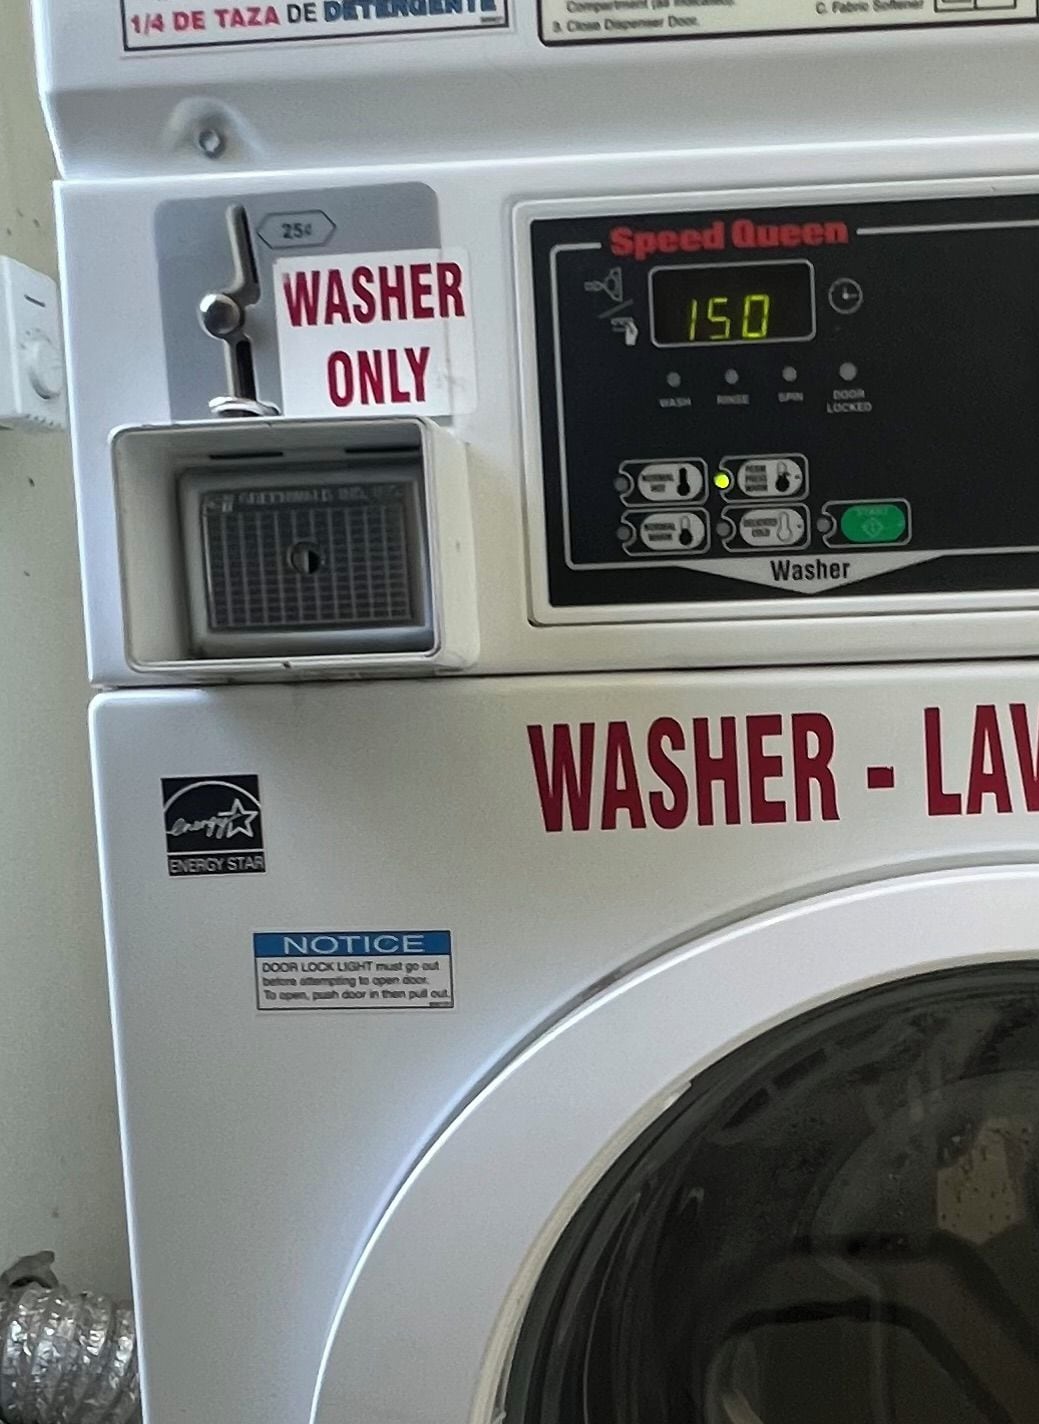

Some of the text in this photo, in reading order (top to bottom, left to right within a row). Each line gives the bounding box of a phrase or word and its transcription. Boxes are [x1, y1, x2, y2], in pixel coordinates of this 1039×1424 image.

[130, 13, 165, 36] 1/4
[172, 10, 206, 32] DE
[214, 6, 281, 29] TAZA
[287, 3, 318, 24] DE
[609, 219, 849, 262] Speed Queen
[282, 262, 466, 327] WASHER
[688, 293, 770, 342] 150
[327, 347, 431, 407] ONLY
[826, 401, 873, 413] LOCKED
[769, 558, 852, 582] Washer
[526, 711, 841, 833] WASHER
[866, 765, 895, 790] -
[169, 855, 265, 874] ENERGY STAR
[283, 934, 426, 955] NOTICE
[262, 961, 299, 973] DOOR
[300, 961, 335, 973] LOCK
[336, 960, 374, 972] LIGHT
[405, 962, 420, 974] go
